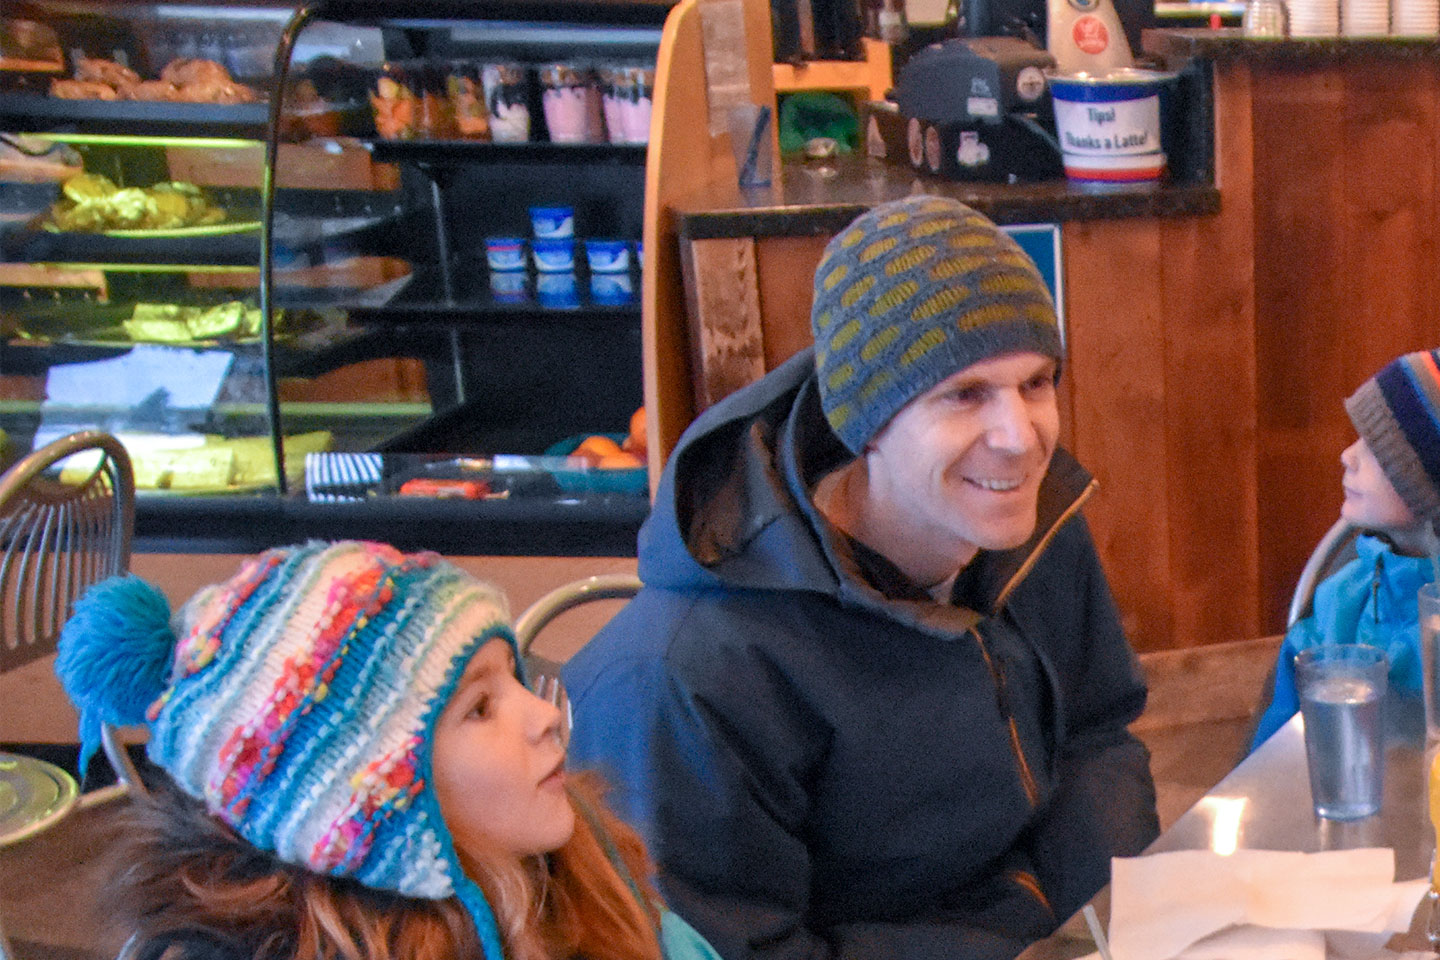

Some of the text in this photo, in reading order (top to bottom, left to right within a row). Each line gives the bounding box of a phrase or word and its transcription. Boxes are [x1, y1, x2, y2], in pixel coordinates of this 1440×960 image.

[1088, 107, 1116, 125] Tips!
[1065, 131, 1149, 149] Thanks a Latte!
